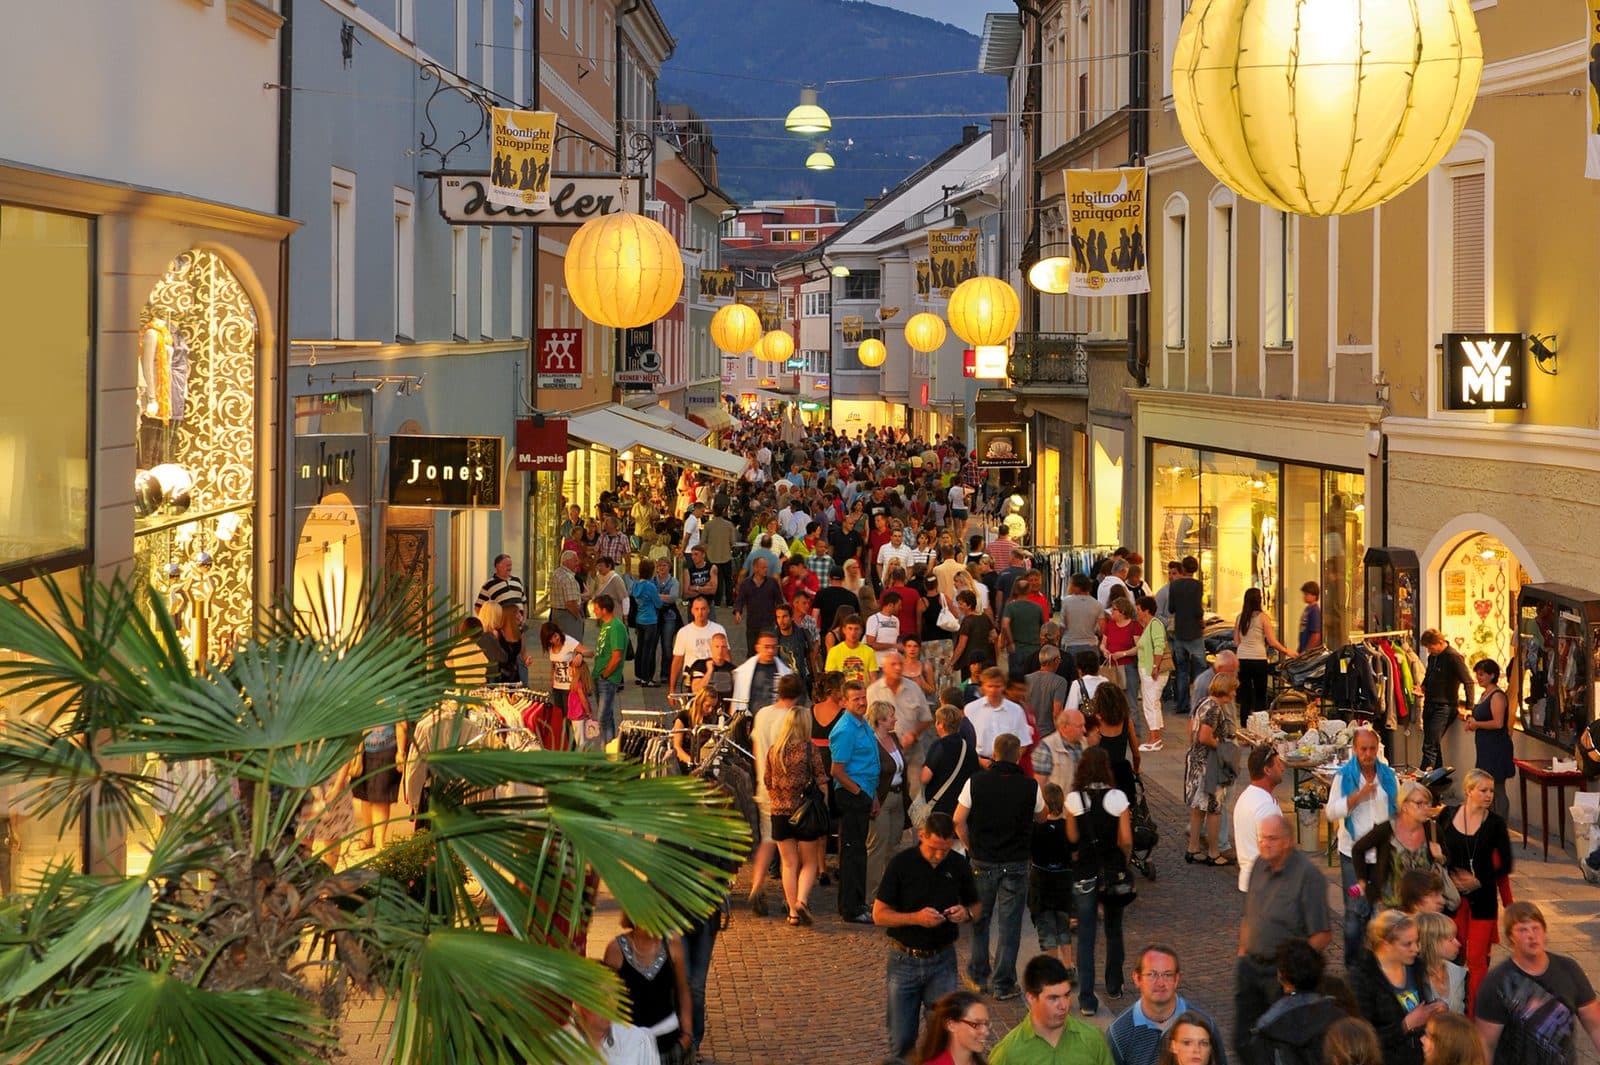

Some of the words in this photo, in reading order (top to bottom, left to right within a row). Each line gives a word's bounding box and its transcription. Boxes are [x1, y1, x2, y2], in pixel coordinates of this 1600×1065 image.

[496, 125, 550, 141] Moonlight
[496, 136, 549, 153] Shopping
[1460, 341, 1511, 402] WMF
[407, 459, 484, 484] Jones
